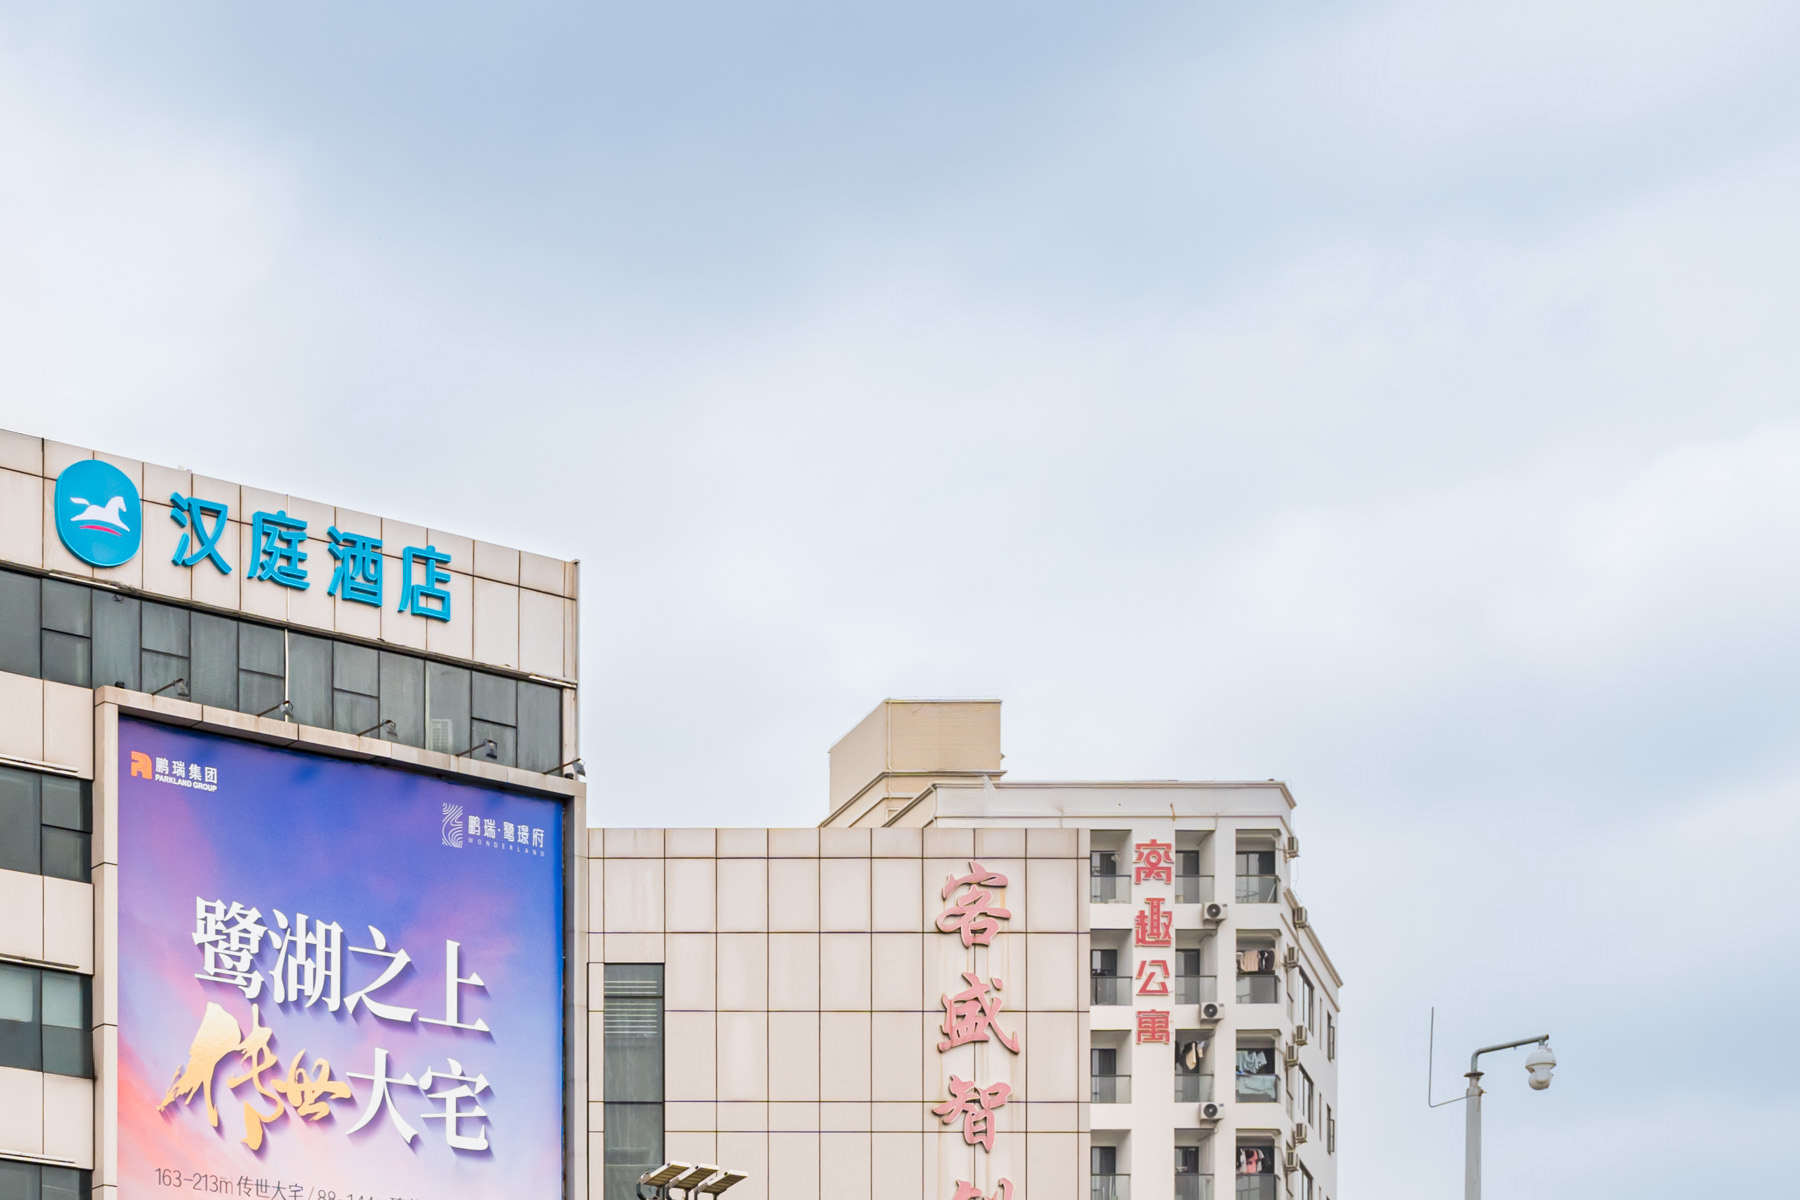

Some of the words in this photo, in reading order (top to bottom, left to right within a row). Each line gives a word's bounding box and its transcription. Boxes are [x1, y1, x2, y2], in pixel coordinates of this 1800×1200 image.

[170, 491, 451, 623] 汉庭酒店
[155, 757, 218, 784] 鹏瑞集团
[155, 774, 193, 788] PARKLAND
[193, 781, 218, 792] GROUP
[467, 837, 545, 857] WONDERLAND
[192, 896, 491, 1033] 鹭湖之上
[1133, 839, 1174, 1045] 窝趣公寓
[157, 1001, 491, 1151] 传世大宅
